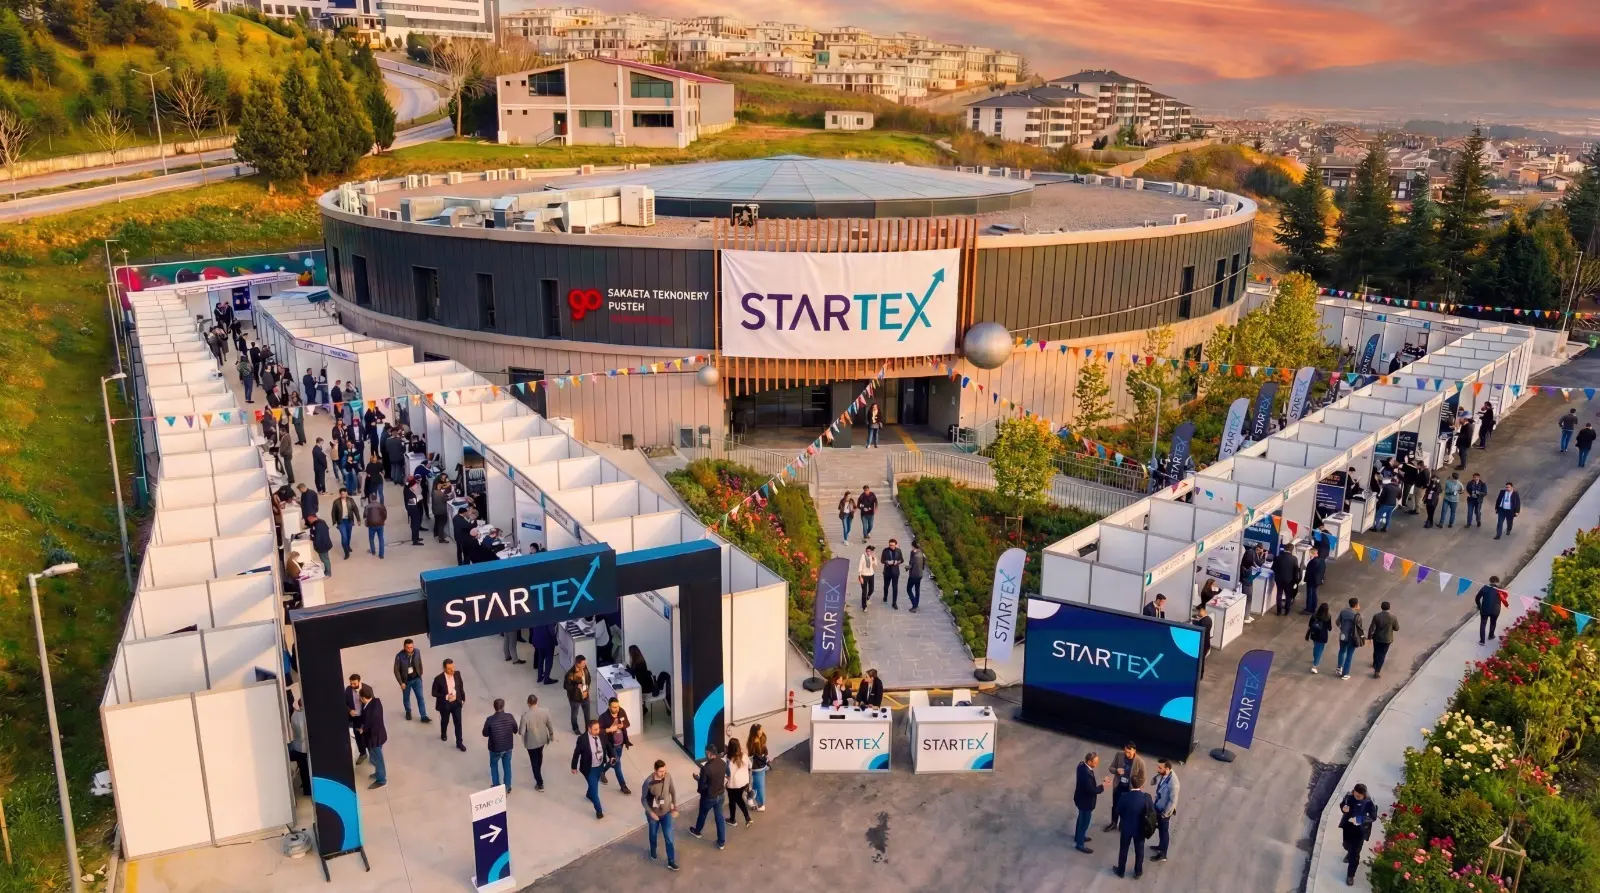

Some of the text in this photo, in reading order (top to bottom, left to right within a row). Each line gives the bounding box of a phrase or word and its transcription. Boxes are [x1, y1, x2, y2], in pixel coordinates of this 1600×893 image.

[607, 288, 709, 301] SAKAETA TEKNONERY
[608, 301, 645, 311] PUSTEH
[740, 267, 945, 342] STARTEX
[1290, 377, 1308, 419] STARTEX
[1223, 410, 1241, 454] STARTEX
[445, 554, 600, 628] STARTEX
[994, 568, 1017, 642] STARTEX
[821, 578, 841, 651] STARTEX
[1052, 640, 1164, 680] STARTEX
[1236, 666, 1260, 730] STARTEX
[819, 732, 885, 750] STARTEX
[923, 732, 988, 751] STARTEX
